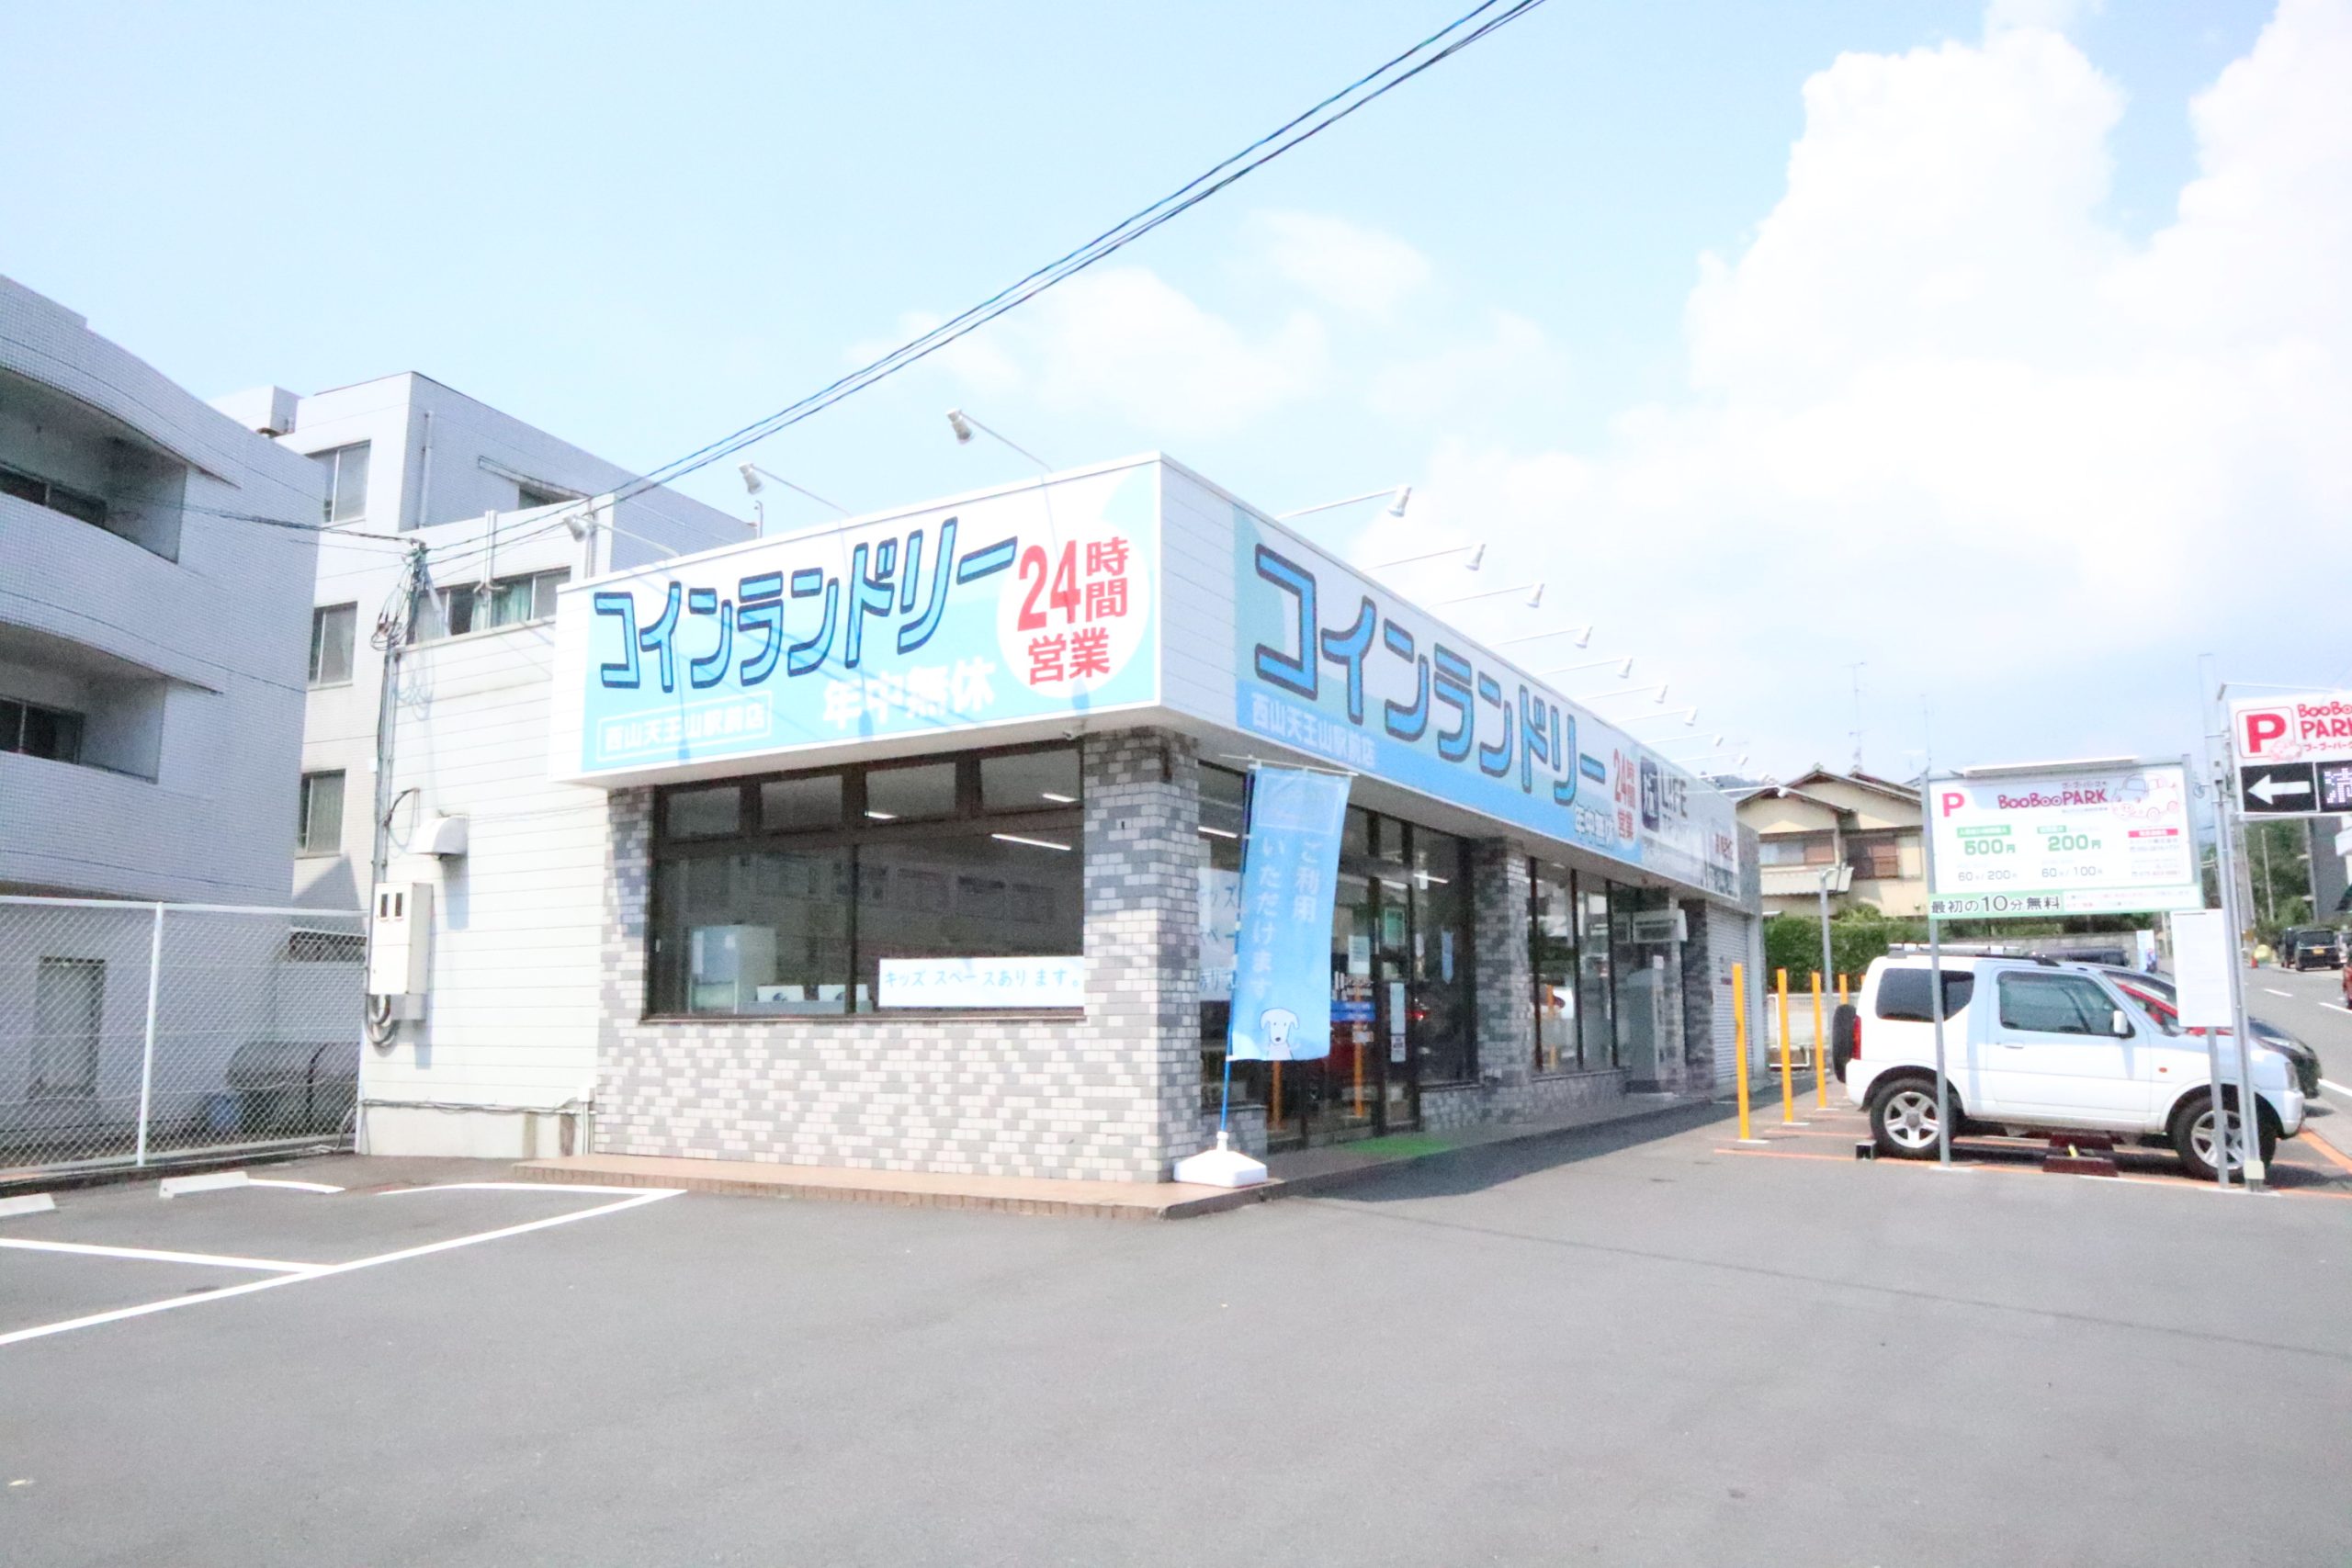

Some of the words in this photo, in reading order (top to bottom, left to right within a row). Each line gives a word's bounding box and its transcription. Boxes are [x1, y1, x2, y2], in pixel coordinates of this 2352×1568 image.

[594, 516, 1018, 693] コインランドリー
[823, 657, 996, 730] 年中無休
[1255, 543, 1605, 806] コインランドリー
[2245, 713, 2287, 753] P
[1941, 792, 1965, 818] P
[1964, 838, 2016, 855] 500円
[2048, 834, 2102, 852] 200円
[1294, 840, 1322, 923] ご利用
[1930, 894, 2061, 915] 最初の10分無料
[1250, 836, 1284, 999] いただけます
